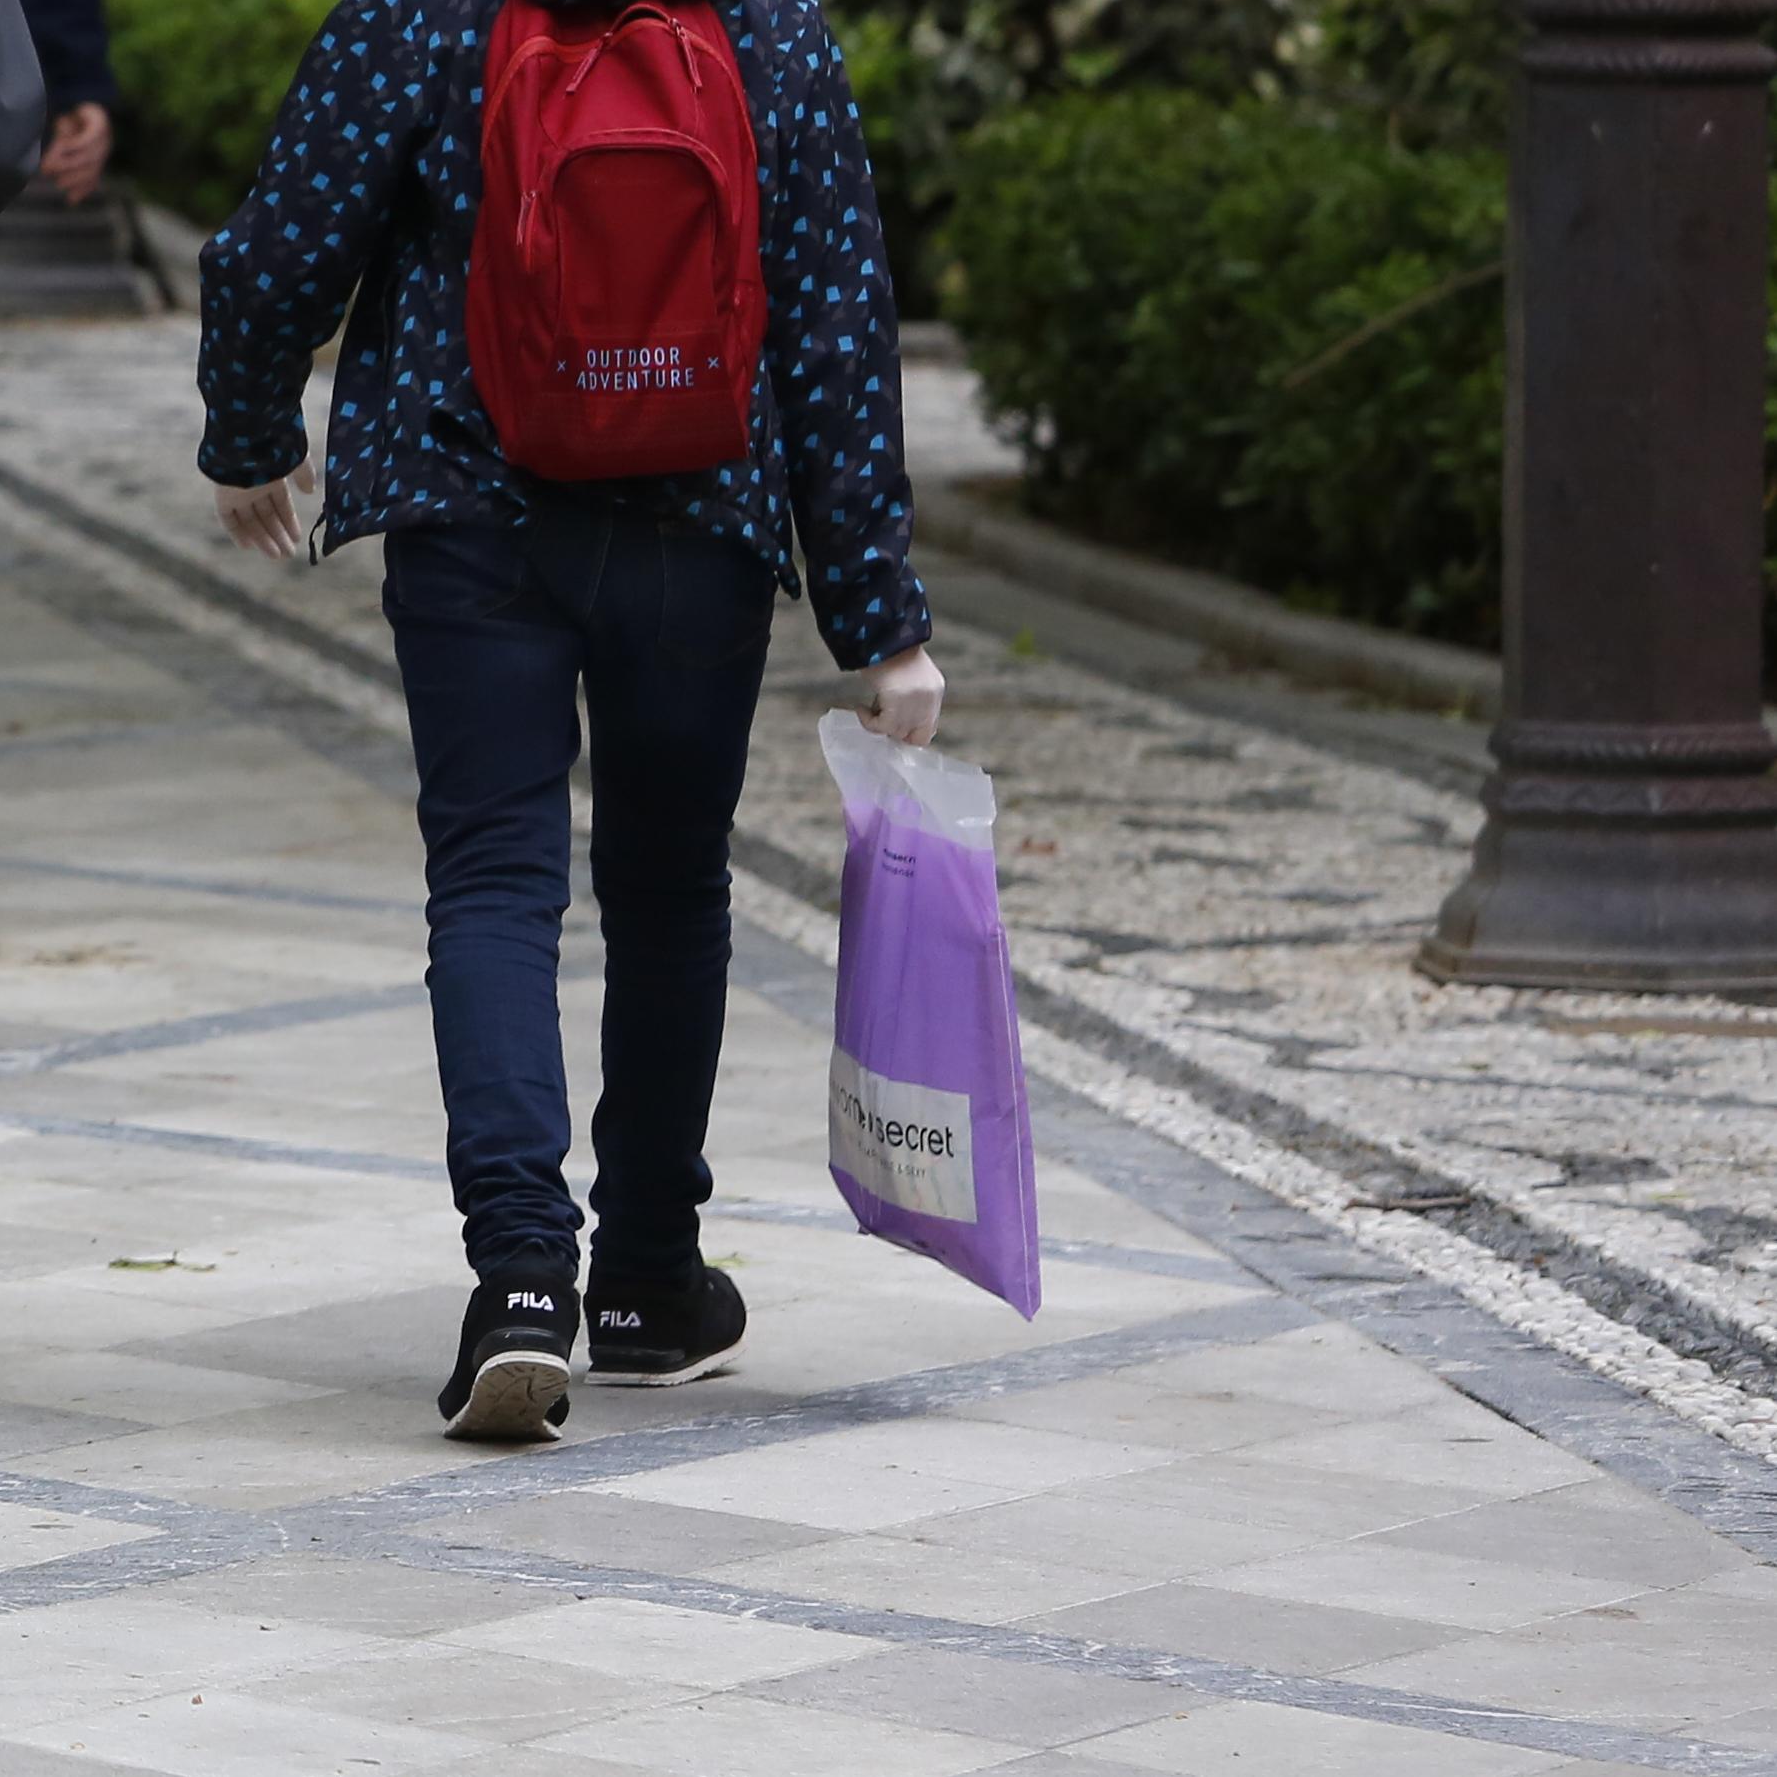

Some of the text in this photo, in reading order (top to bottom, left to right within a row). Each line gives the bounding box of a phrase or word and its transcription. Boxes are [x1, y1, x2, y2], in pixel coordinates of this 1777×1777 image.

[586, 347, 681, 369] OUTDOOR
[576, 368, 695, 391] ADVENTURE
[507, 1291, 555, 1312] FILA
[599, 1310, 642, 1328] FILA
